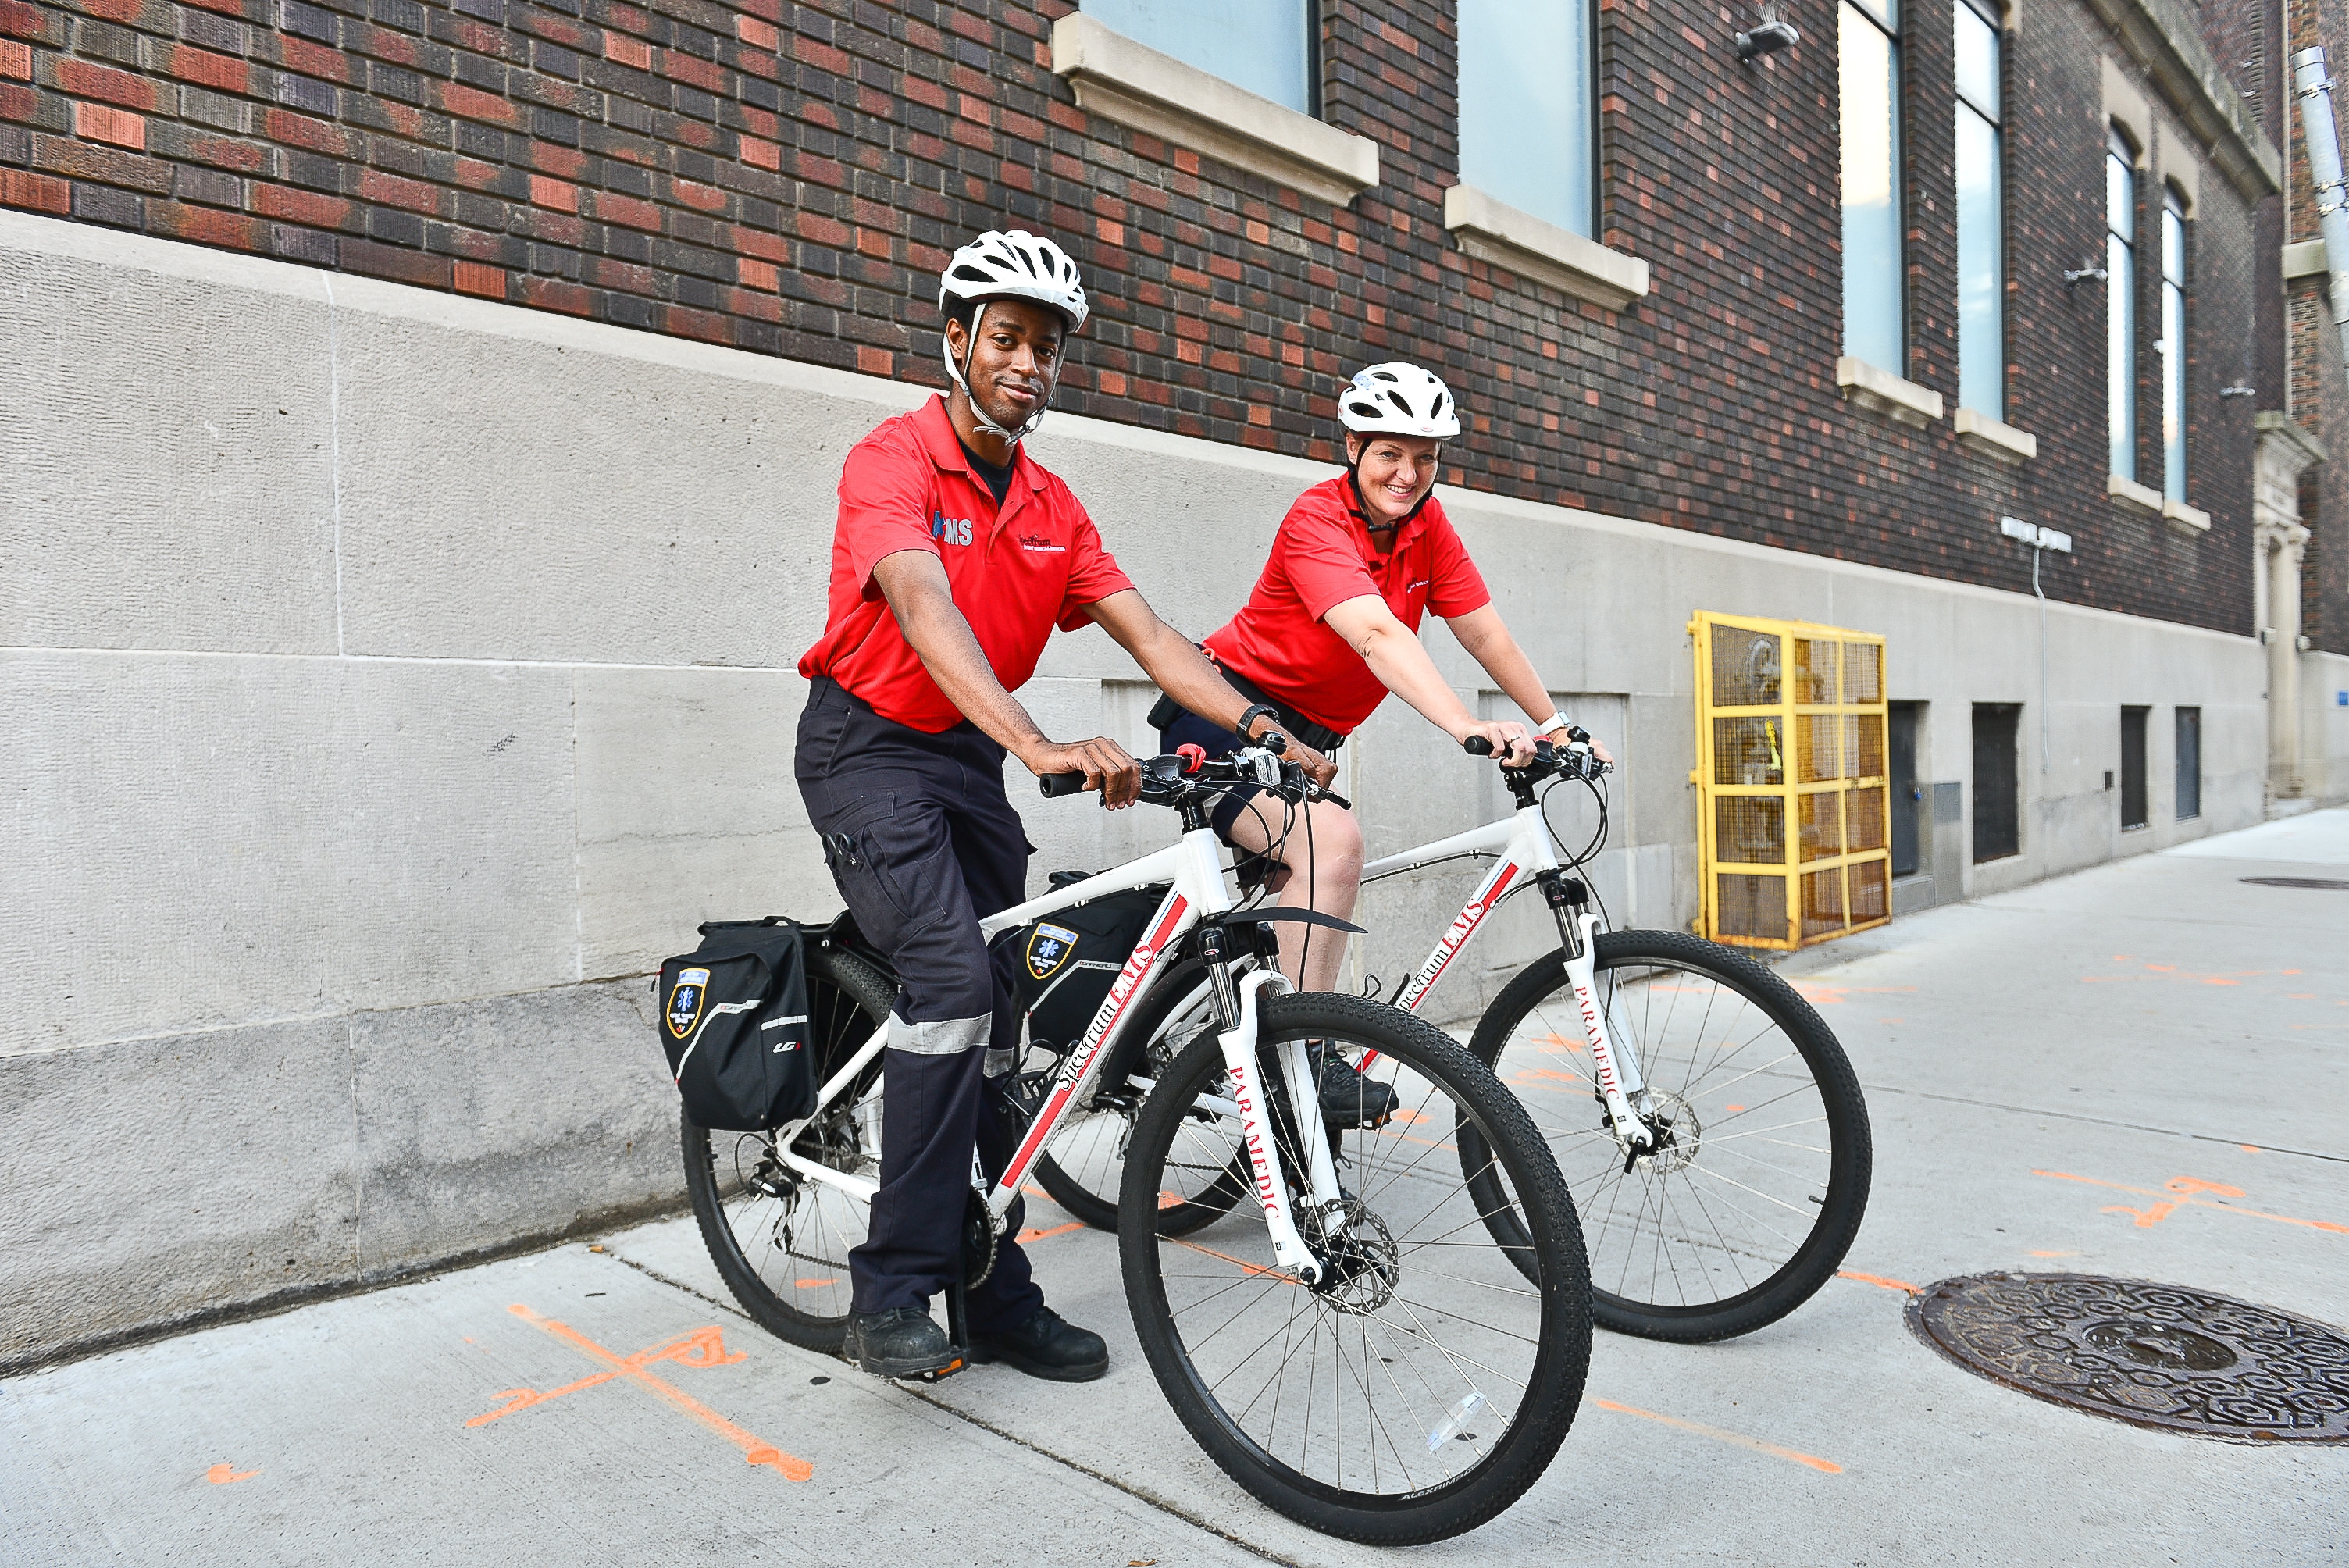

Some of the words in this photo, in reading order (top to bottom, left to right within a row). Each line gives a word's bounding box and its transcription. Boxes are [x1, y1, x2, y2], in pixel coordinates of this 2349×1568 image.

[1058, 1003, 1117, 1090] Spectrum
[1110, 940, 1153, 1005] EMS
[1398, 950, 1449, 1014] pectrum
[1442, 898, 1483, 950] EMS
[1575, 986, 1620, 1100] PARAMEDIC
[1230, 1067, 1280, 1219] PARAMEDIC
